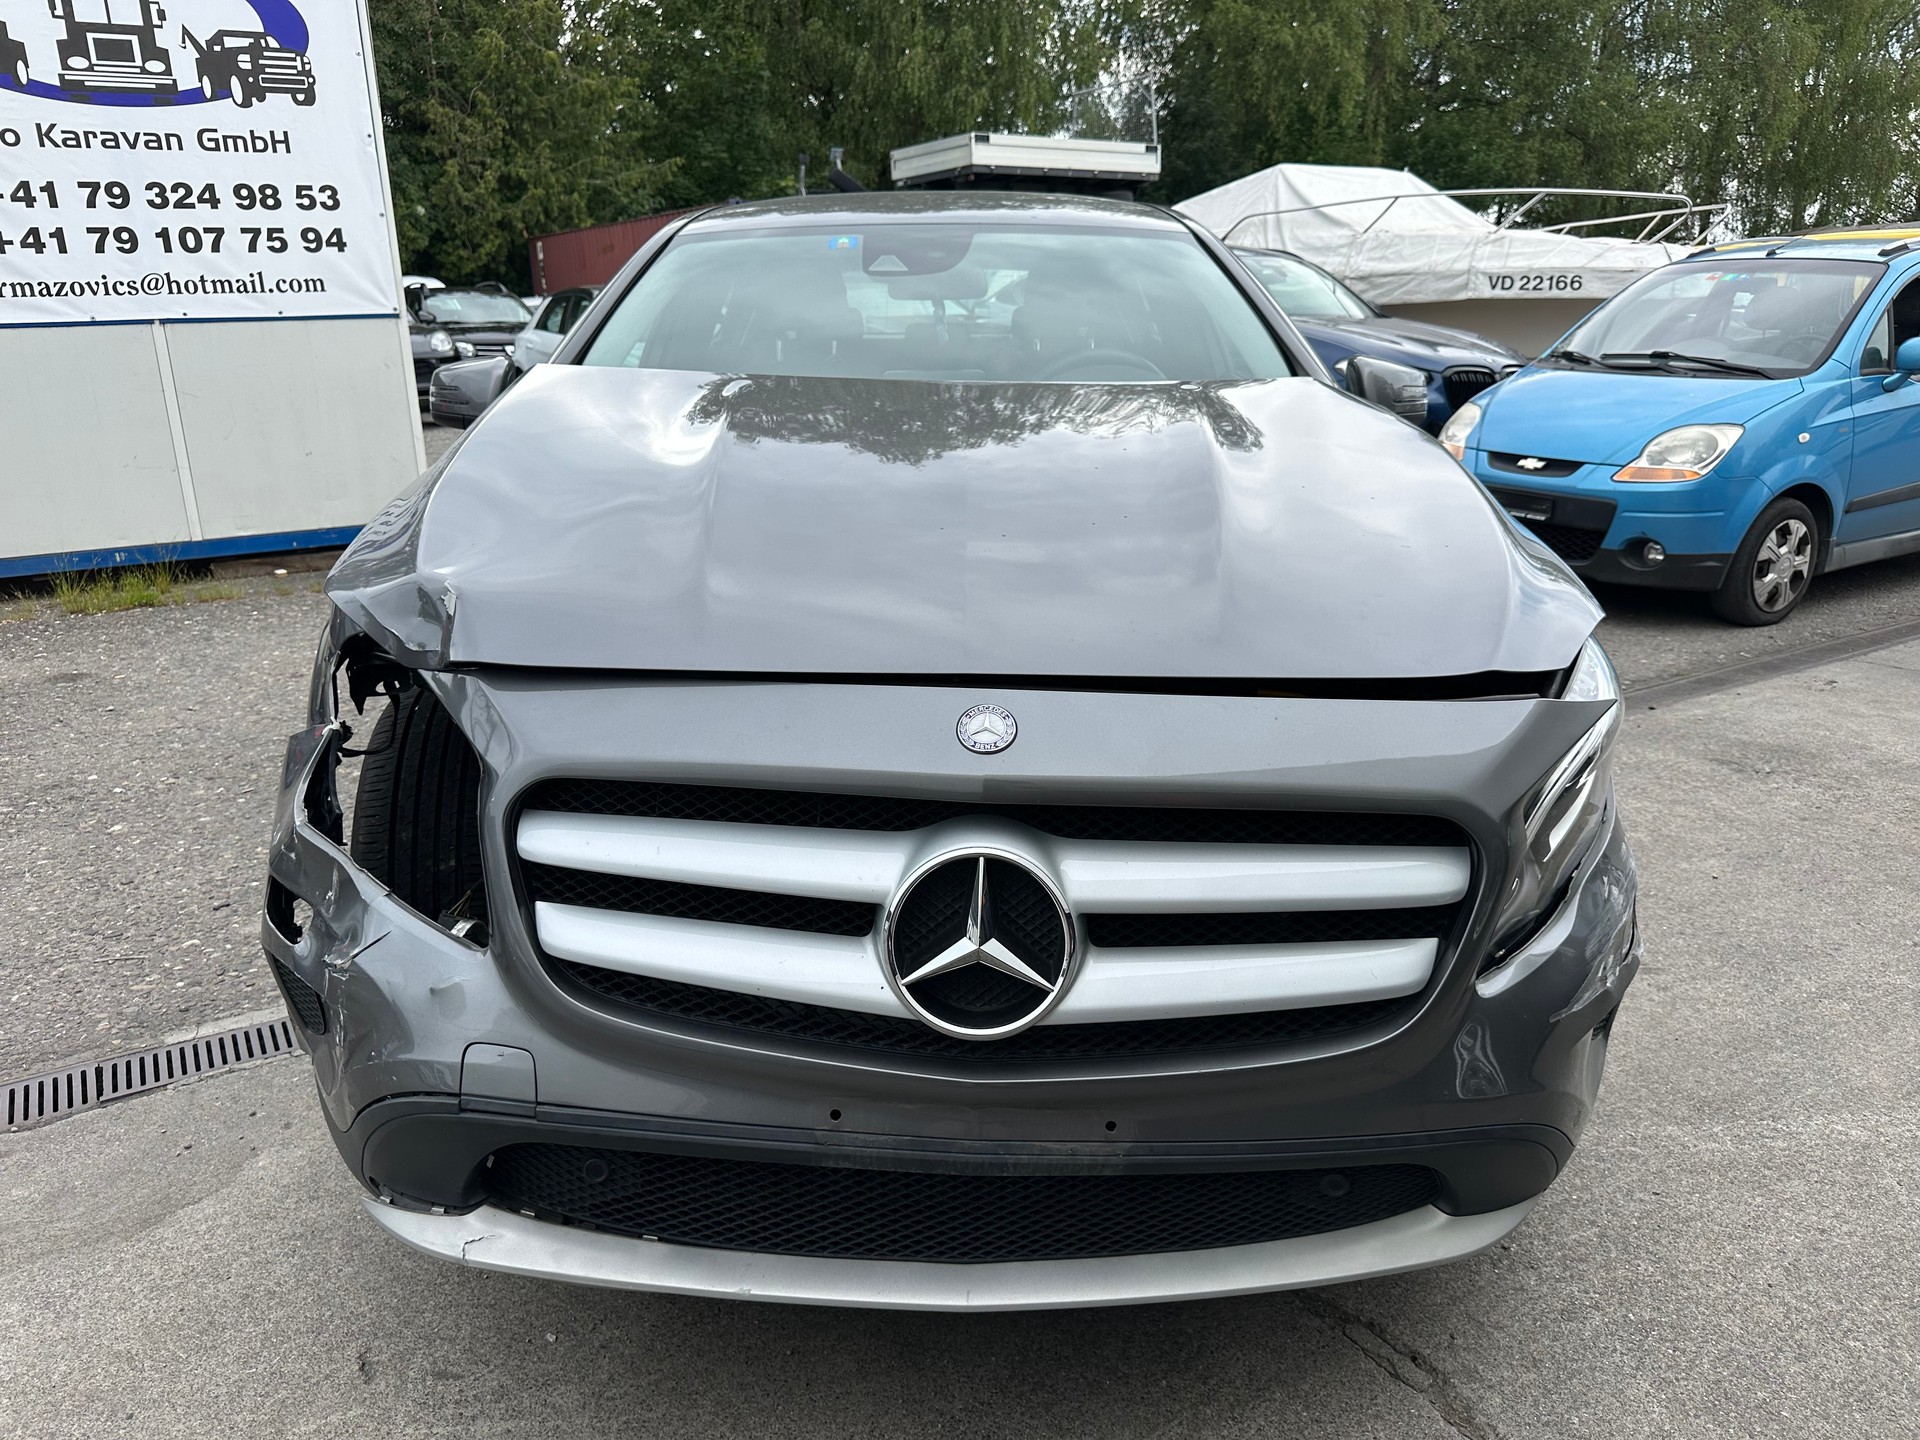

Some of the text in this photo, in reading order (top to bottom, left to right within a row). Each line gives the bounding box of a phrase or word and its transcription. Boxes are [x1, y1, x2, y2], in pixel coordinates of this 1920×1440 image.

[35, 122, 184, 151] Karavan
[197, 128, 292, 154] GmbH
[0, 180, 342, 212] 41 79 324 98 53
[85, 226, 139, 255] 79
[154, 226, 226, 254] 107
[239, 227, 289, 254] 75
[300, 226, 347, 253] 94
[1488, 274, 1583, 291] VD 22166
[974, 742, 996, 750] BENZ
